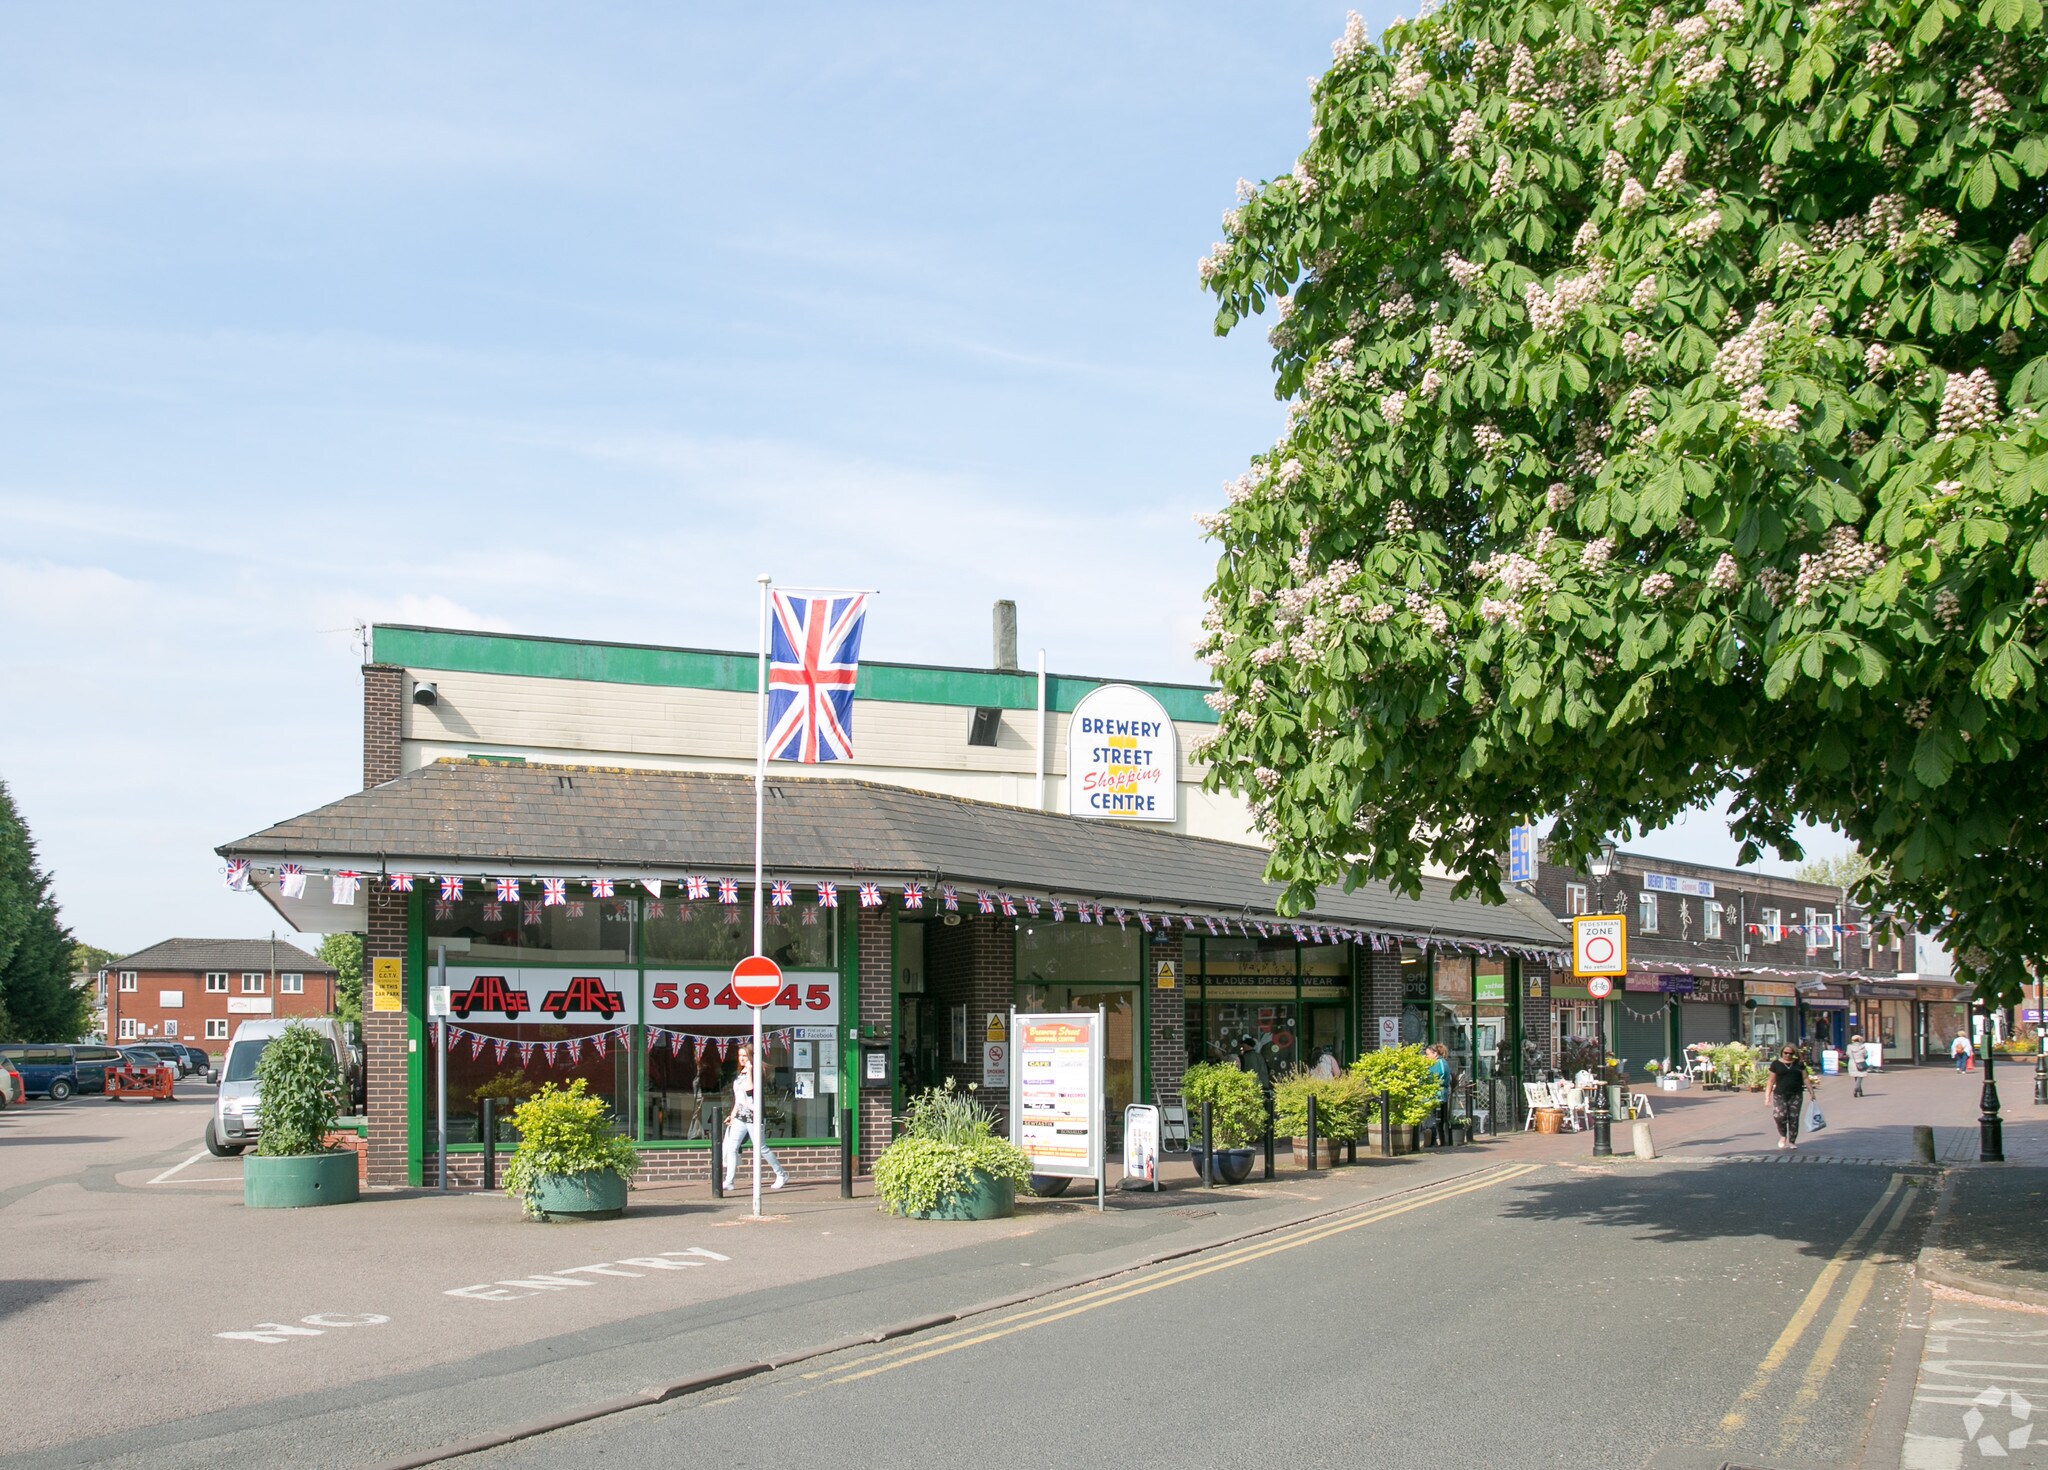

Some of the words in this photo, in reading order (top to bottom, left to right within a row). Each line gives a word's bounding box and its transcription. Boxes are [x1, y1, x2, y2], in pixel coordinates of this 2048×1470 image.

[1082, 717, 1161, 738] BREWERY
[1093, 747, 1153, 765] STREET
[1083, 768, 1162, 790] Shopping
[1090, 793, 1155, 811] CENTRE
[1205, 976, 1212, 985] &
[1216, 977, 1255, 985] LADIES
[1258, 977, 1293, 986] DRESS
[1303, 977, 1333, 986] WEAR
[451, 977, 529, 1011] CHASE
[543, 978, 622, 1011] CARS
[652, 982, 831, 1011] 58445
[1029, 1026, 1057, 1037] Brewery
[1058, 1026, 1081, 1037] Street
[213, 1311, 391, 1344] NO
[443, 1247, 732, 1301] ENTRY
